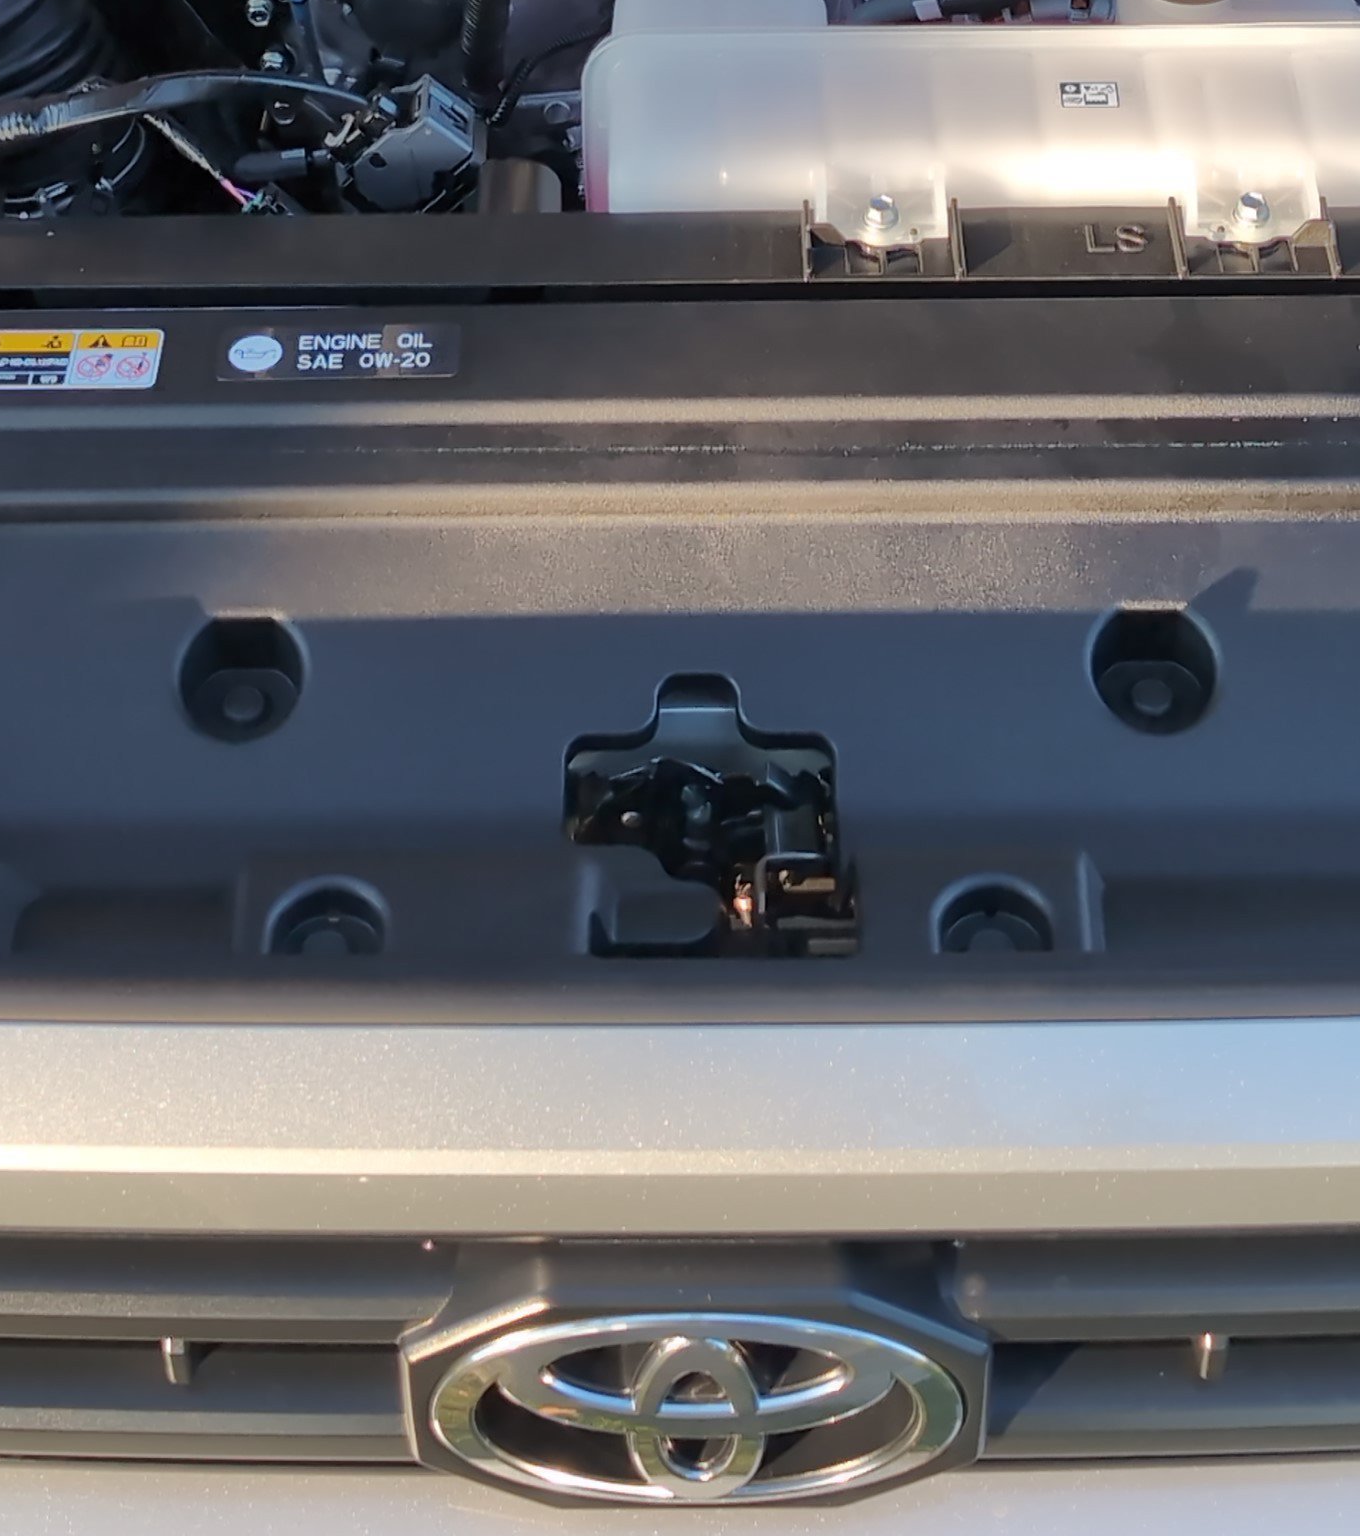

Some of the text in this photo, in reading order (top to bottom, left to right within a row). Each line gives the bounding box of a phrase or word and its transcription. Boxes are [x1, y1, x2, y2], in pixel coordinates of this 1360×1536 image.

[1084, 224, 1147, 253] LS
[298, 333, 433, 351] ENGINE OIL
[297, 352, 432, 370] SAE 0W-20
